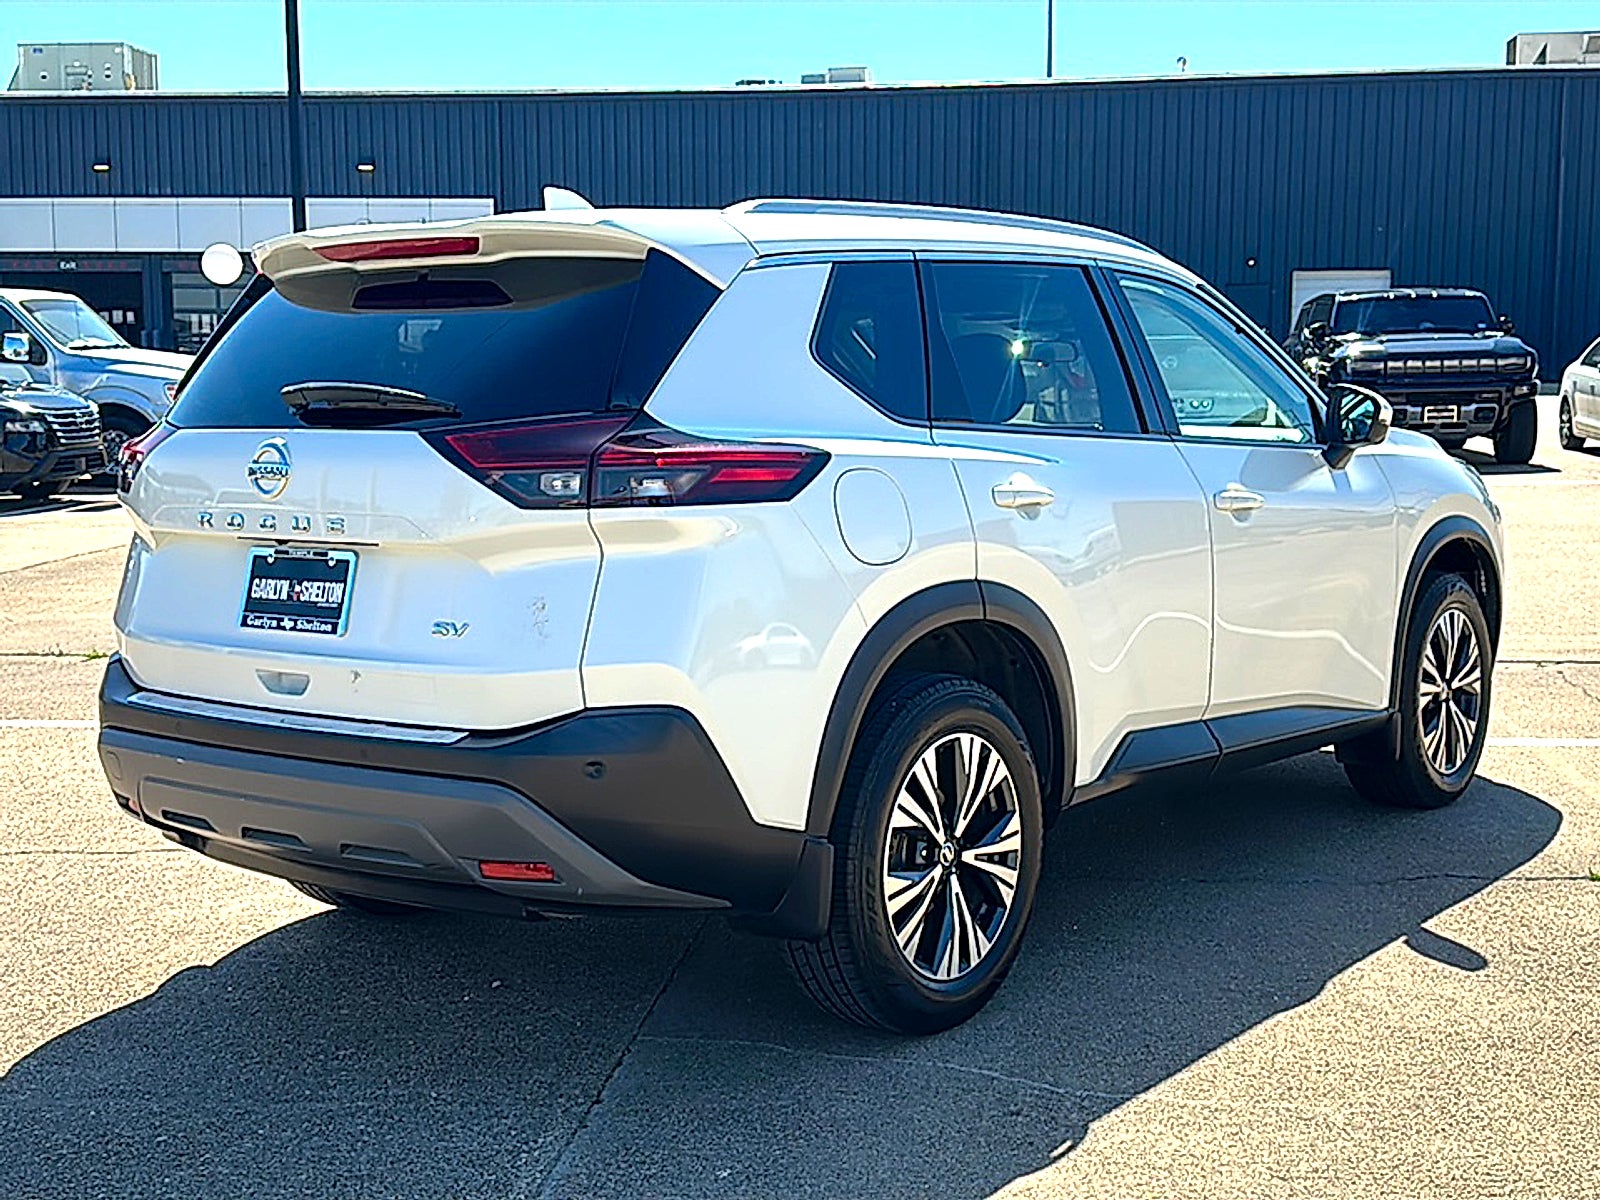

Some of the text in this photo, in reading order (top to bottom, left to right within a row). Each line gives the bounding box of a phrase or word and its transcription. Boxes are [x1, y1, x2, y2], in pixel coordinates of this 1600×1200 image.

[248, 466, 289, 477] NISSAN
[198, 512, 346, 534] ROGUE
[300, 581, 345, 603] SHELTON
[432, 620, 470, 637] SV
